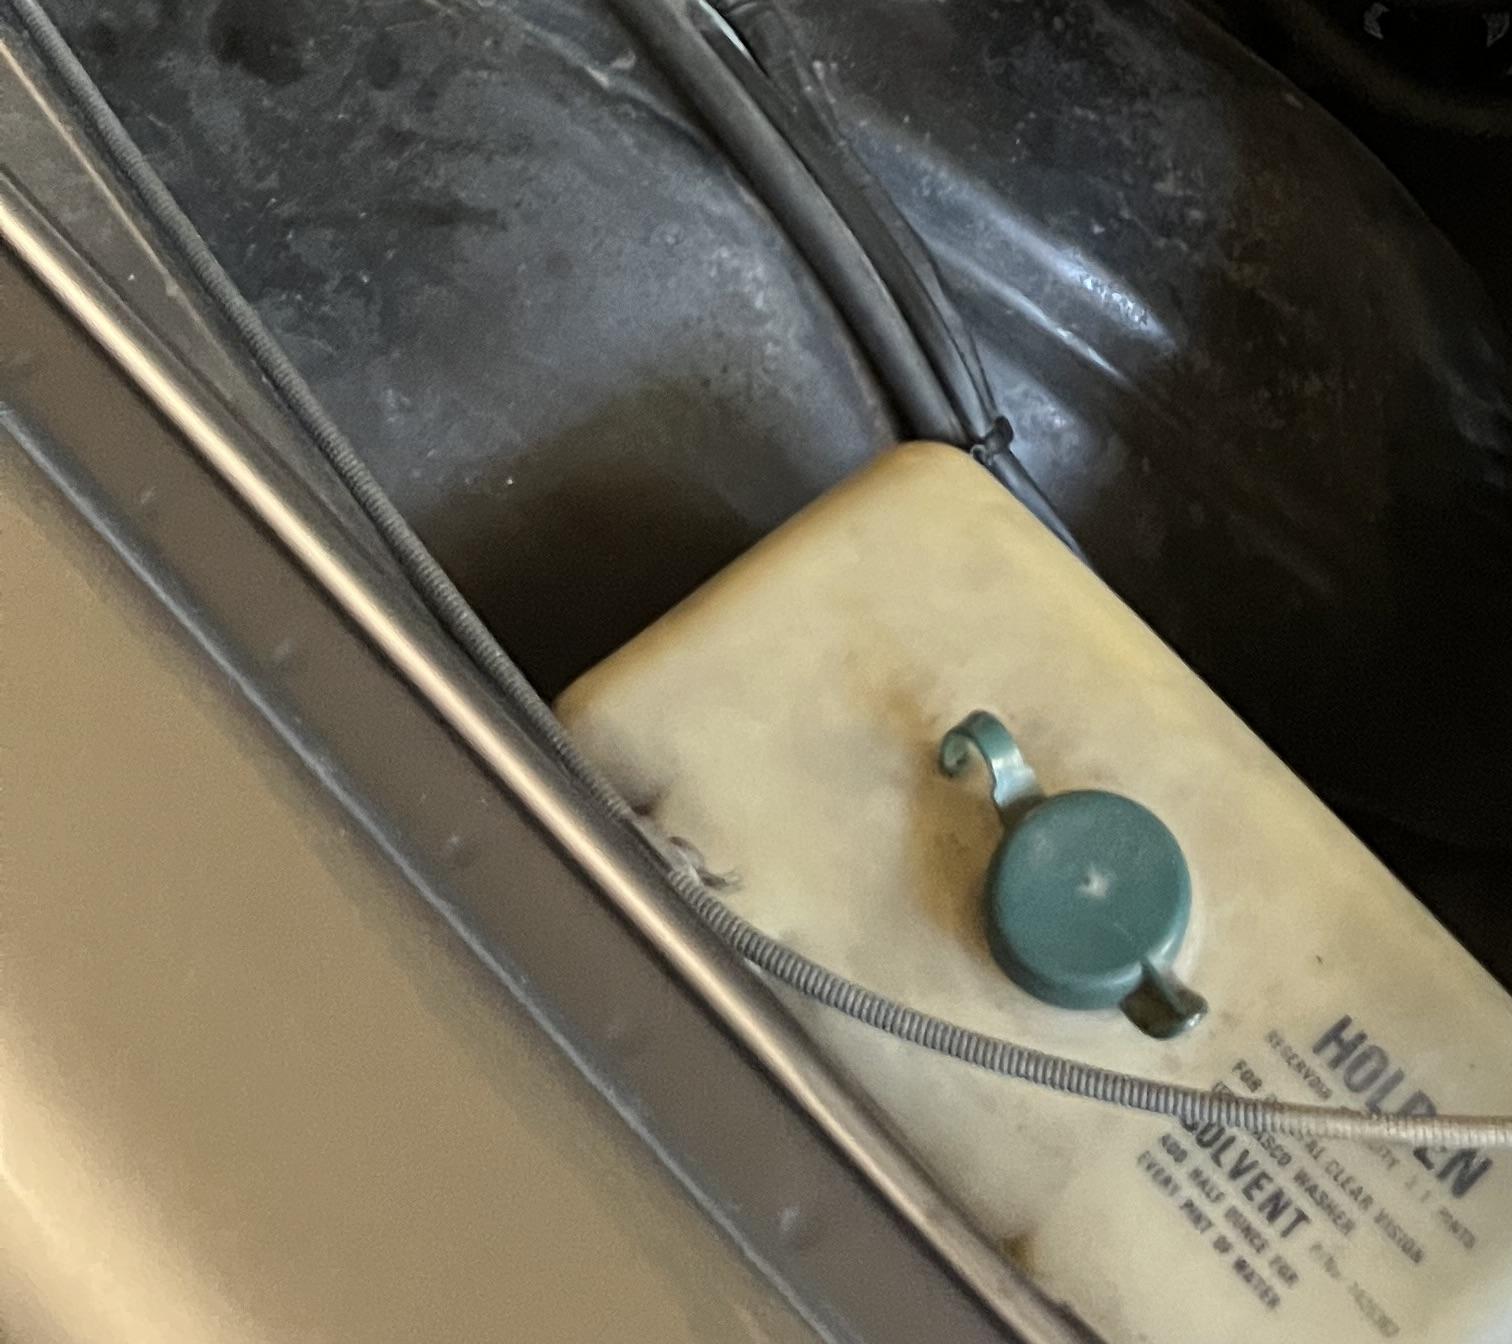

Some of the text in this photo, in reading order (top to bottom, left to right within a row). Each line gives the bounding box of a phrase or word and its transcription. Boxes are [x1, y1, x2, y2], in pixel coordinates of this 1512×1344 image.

[1232, 1060, 1262, 1092] FOR
[1324, 1160, 1375, 1211] CLEAR
[1373, 1210, 1425, 1264] VISION
[1293, 1169, 1355, 1235] WASHER
[1231, 1256, 1281, 1311] WATER
